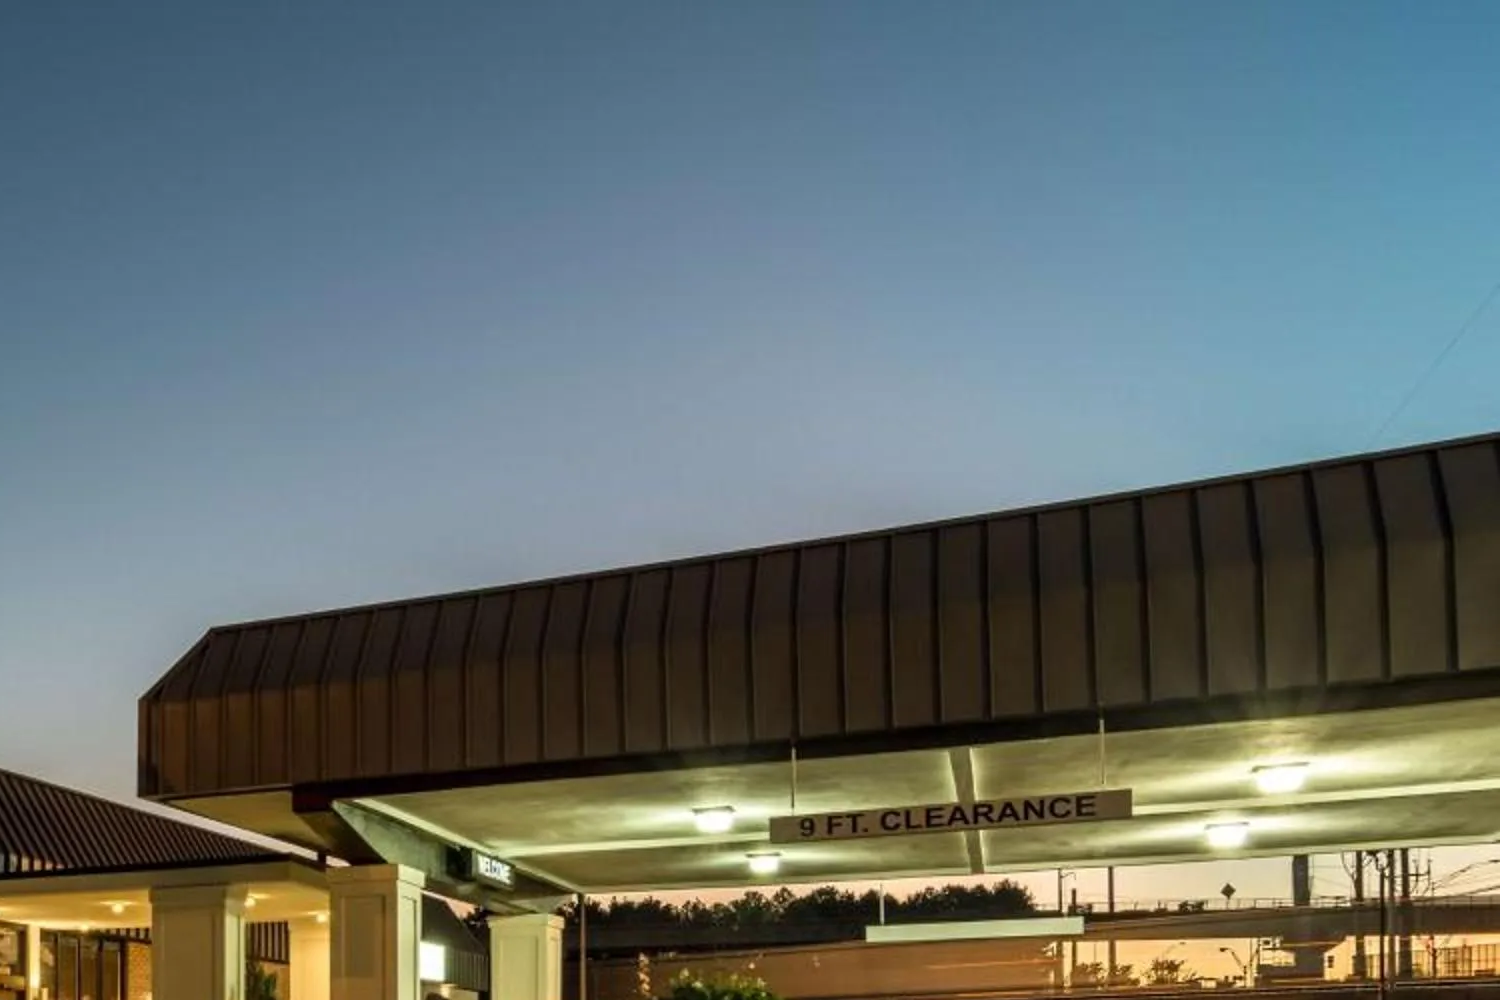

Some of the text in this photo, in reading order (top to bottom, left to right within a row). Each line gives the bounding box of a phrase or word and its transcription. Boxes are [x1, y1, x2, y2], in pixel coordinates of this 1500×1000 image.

[800, 794, 1098, 837] 9 FT. CLEARANCE
